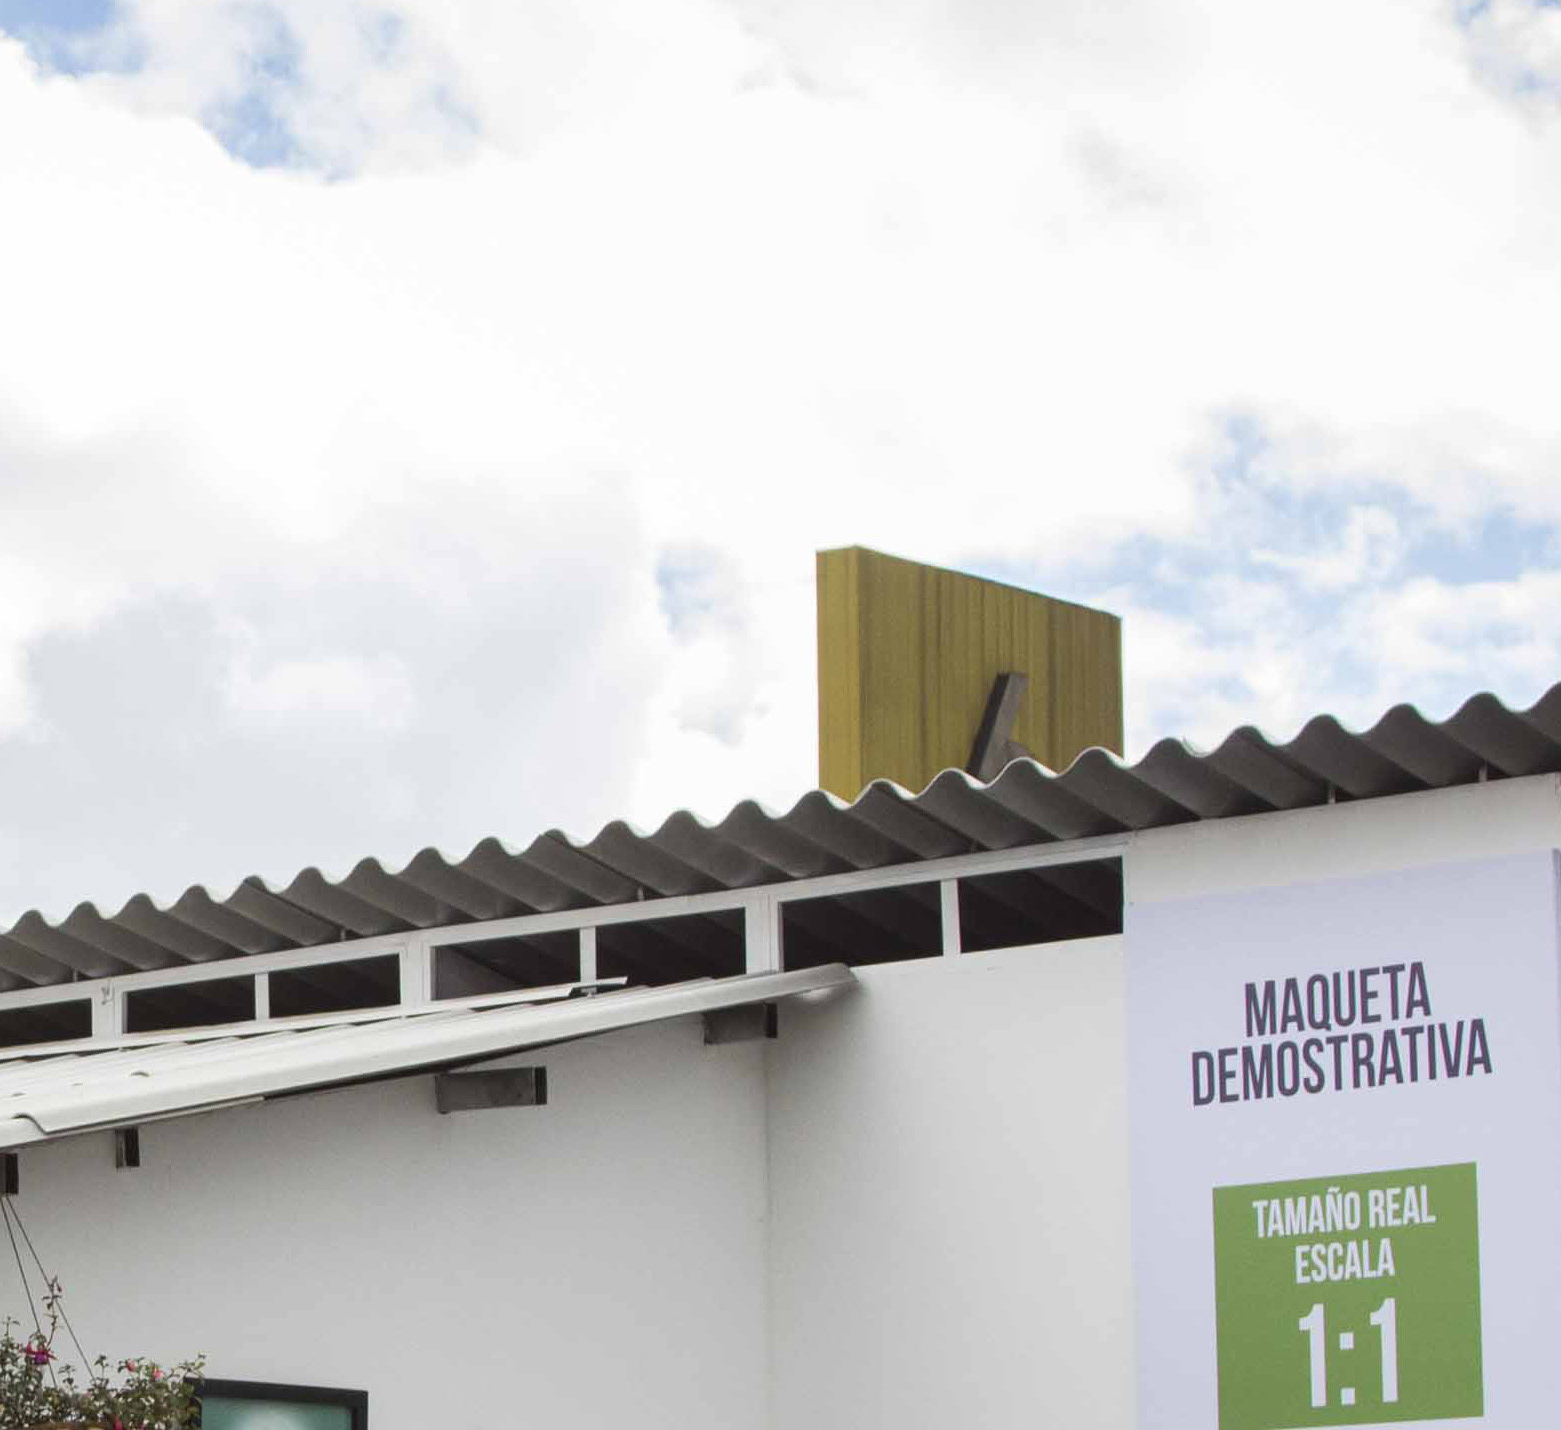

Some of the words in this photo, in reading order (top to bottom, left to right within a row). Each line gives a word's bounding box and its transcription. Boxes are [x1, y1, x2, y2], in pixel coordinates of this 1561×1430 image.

[1244, 961, 1432, 1037] MAQUETA
[1191, 1018, 1493, 1106] DEMOSTRATIVA
[1252, 1186, 1361, 1238] TAMAÑO
[1368, 1184, 1437, 1229] REAL
[1295, 1238, 1396, 1284] ESCALA
[1299, 1298, 1399, 1408] 1:1
